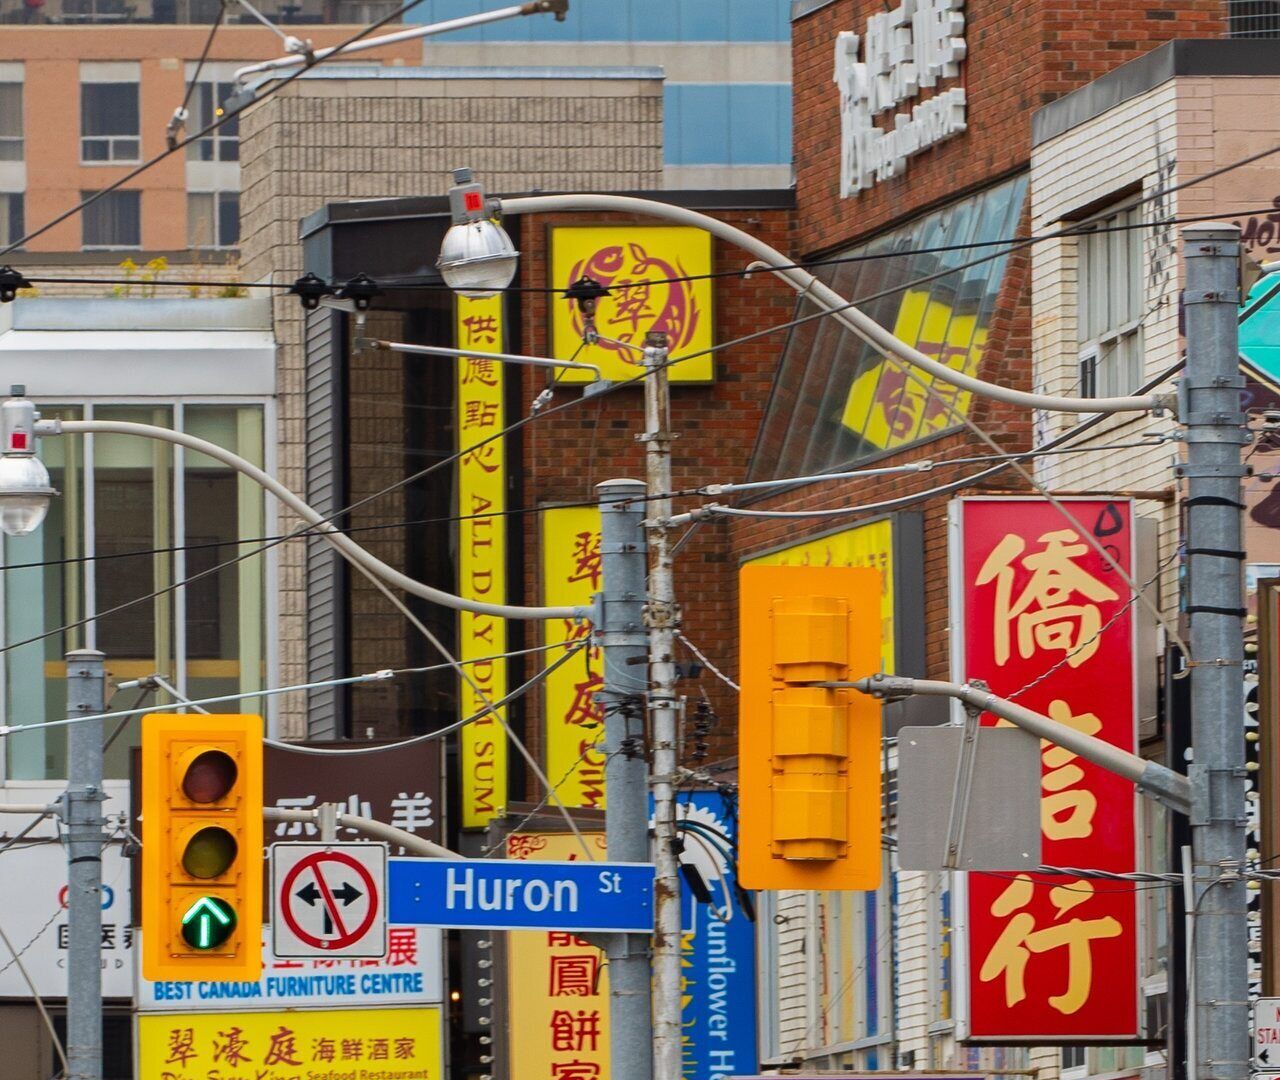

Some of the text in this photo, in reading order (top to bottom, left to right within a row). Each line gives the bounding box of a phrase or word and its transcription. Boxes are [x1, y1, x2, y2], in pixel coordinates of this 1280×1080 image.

[461, 296, 500, 474] 供應點心
[472, 494, 492, 557] ALL
[472, 660, 494, 728] DIM
[474, 741, 495, 815] SUM
[445, 867, 622, 912] Huron St
[154, 972, 424, 1000] BEST CANADA FURNITURE CENTRE
[707, 907, 736, 1040] Sunflower
[306, 1069, 428, 1080] Seafood Restaurant
[311, 1037, 417, 1062] 海鮮酒家
